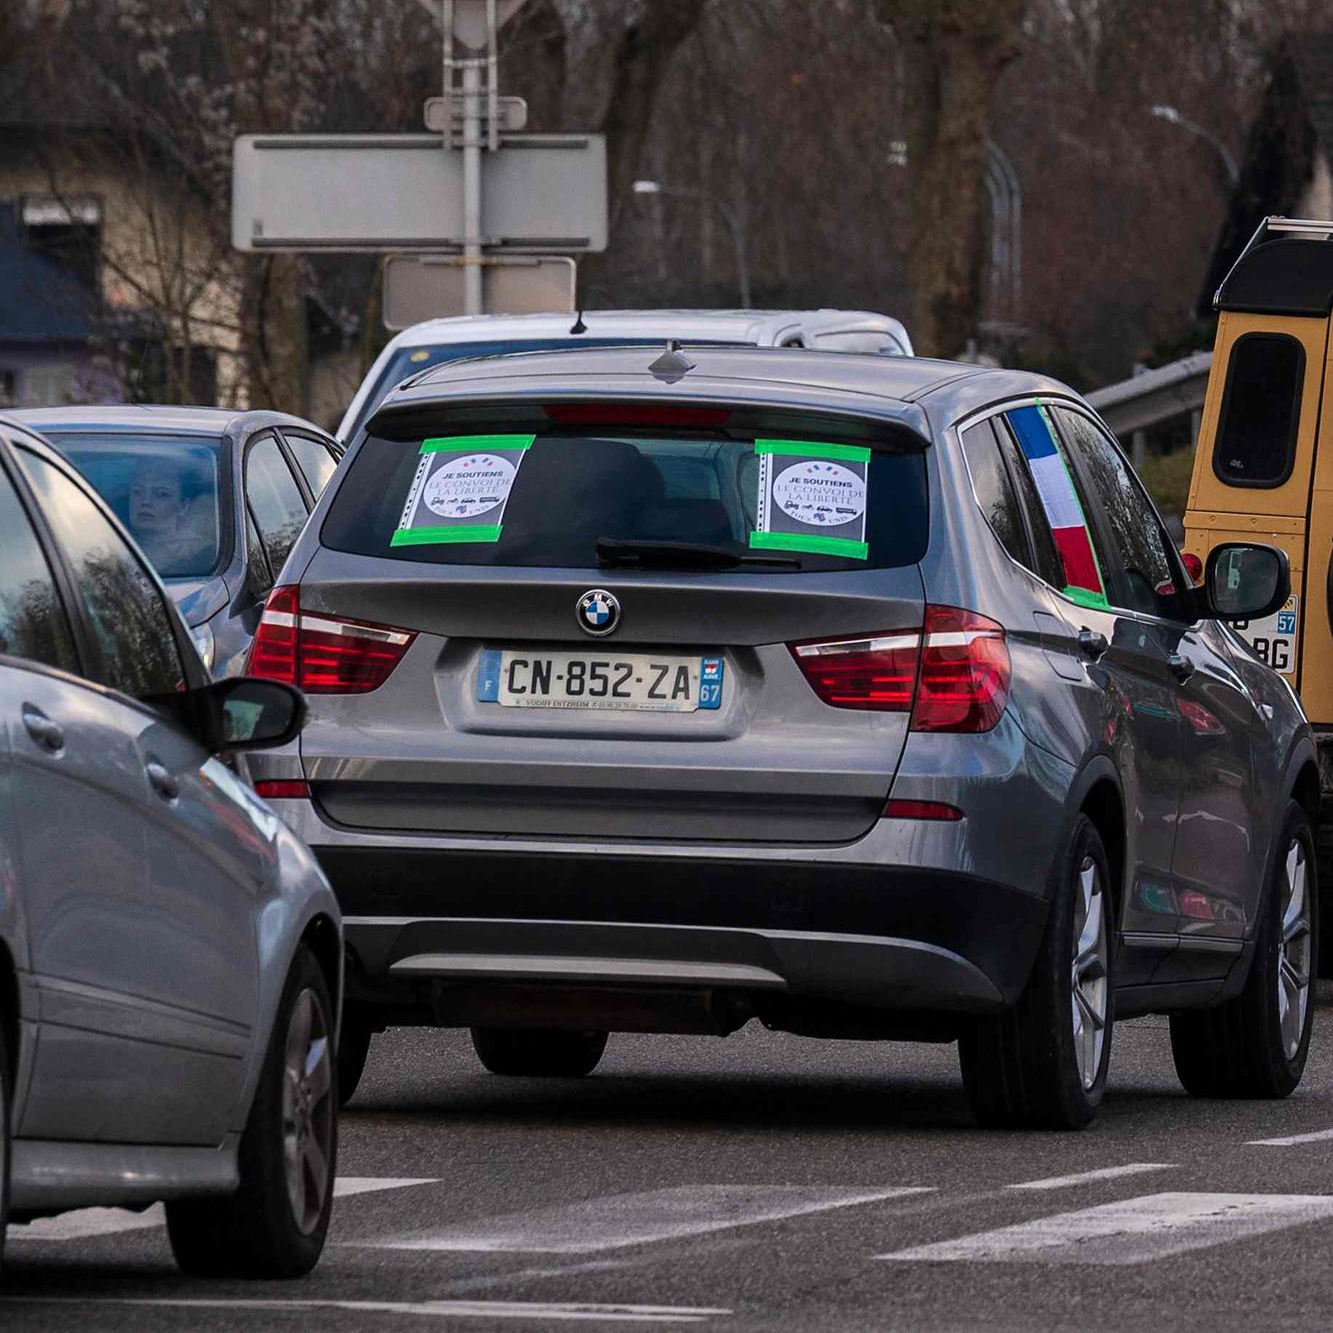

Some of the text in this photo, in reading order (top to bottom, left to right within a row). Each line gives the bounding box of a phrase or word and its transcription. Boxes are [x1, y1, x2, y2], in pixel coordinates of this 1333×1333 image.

[442, 470, 504, 480] JE SOUTIENS
[803, 478, 853, 488] SOUTIENS
[777, 484, 864, 498] LE CONVOI DE
[1278, 615, 1295, 631] 57
[484, 659, 720, 702] F CN-852-ZA 67
